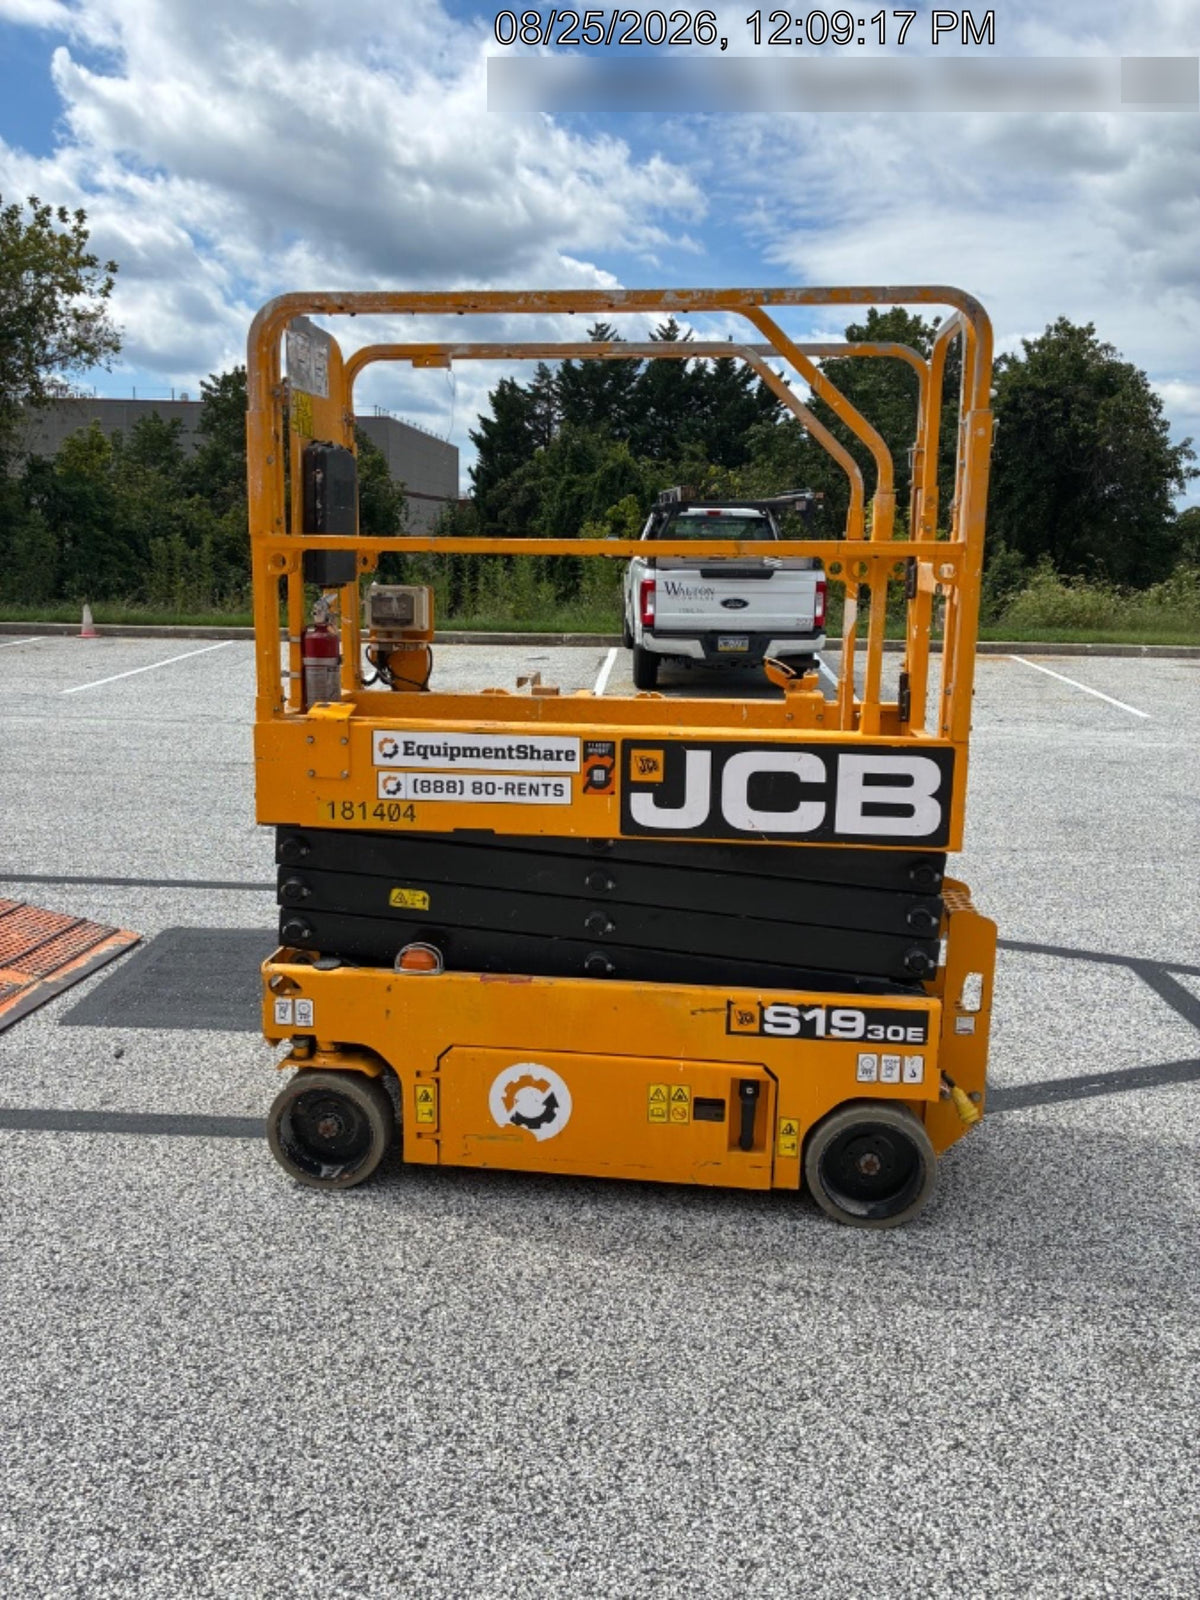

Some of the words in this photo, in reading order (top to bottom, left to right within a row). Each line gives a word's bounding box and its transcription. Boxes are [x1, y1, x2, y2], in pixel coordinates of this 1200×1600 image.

[402, 740, 577, 762] EquipmentShare
[413, 778, 464, 796] (888)
[471, 780, 565, 798] 80-RENTS
[630, 750, 942, 837] JCB
[327, 800, 417, 822] 181404
